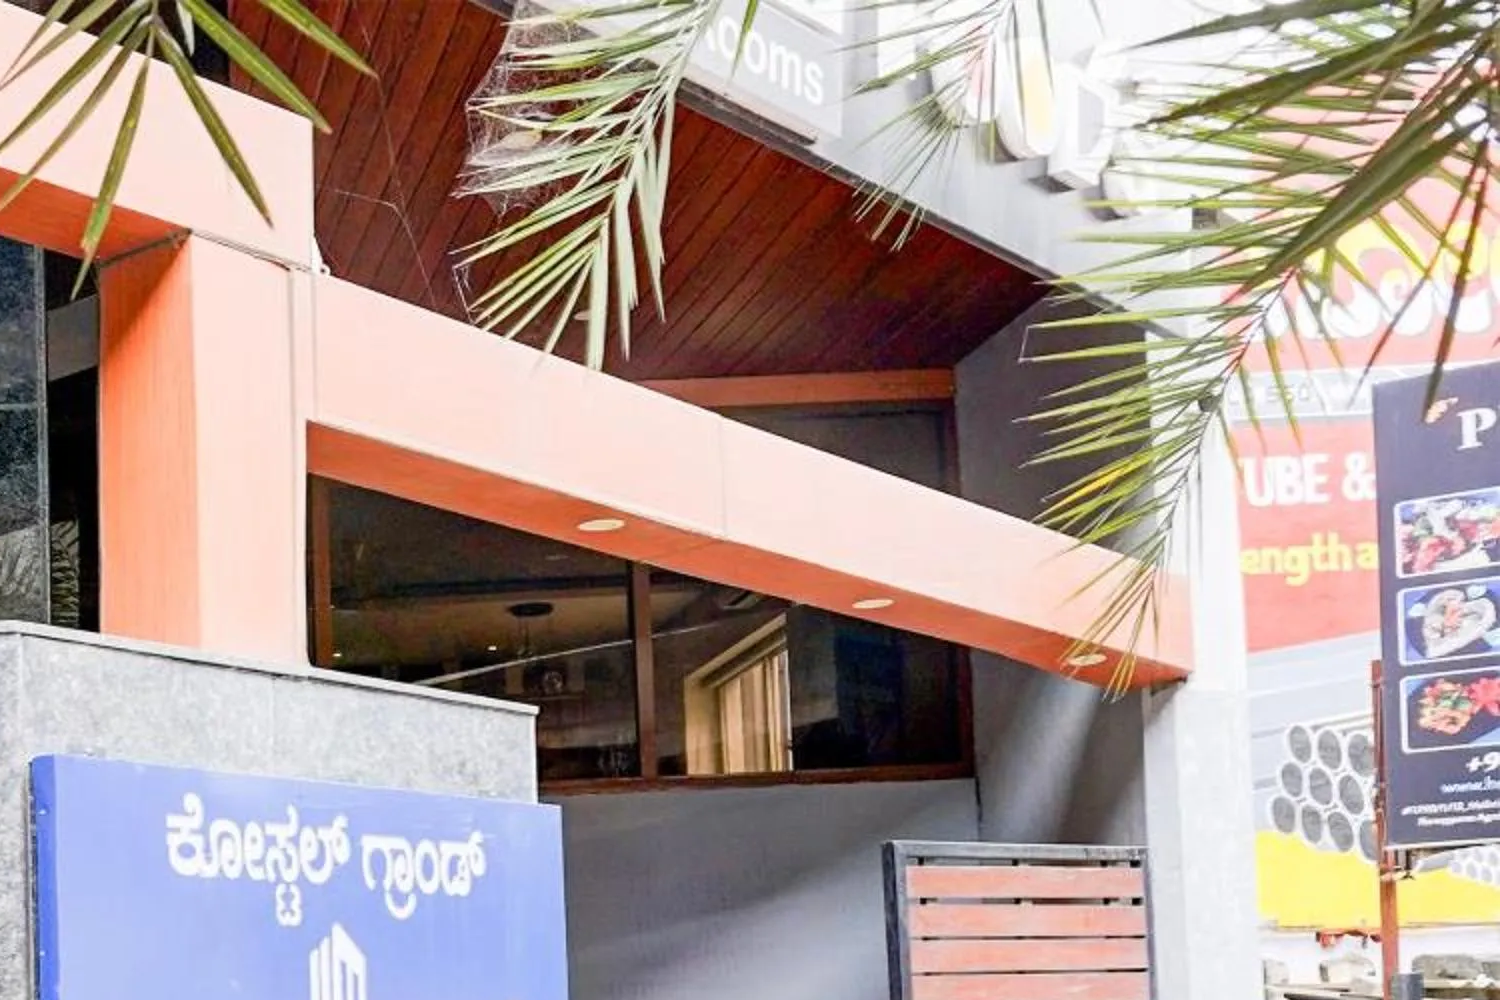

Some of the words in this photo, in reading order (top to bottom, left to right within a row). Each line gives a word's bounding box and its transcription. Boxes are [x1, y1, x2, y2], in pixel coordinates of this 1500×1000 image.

[1239, 453, 1330, 507] UBE
[1342, 452, 1377, 502] &
[165, 792, 351, 926] ಕೋಸ್ಟಲ್
[361, 831, 487, 920] ಗ್ರಾಂಡ್
